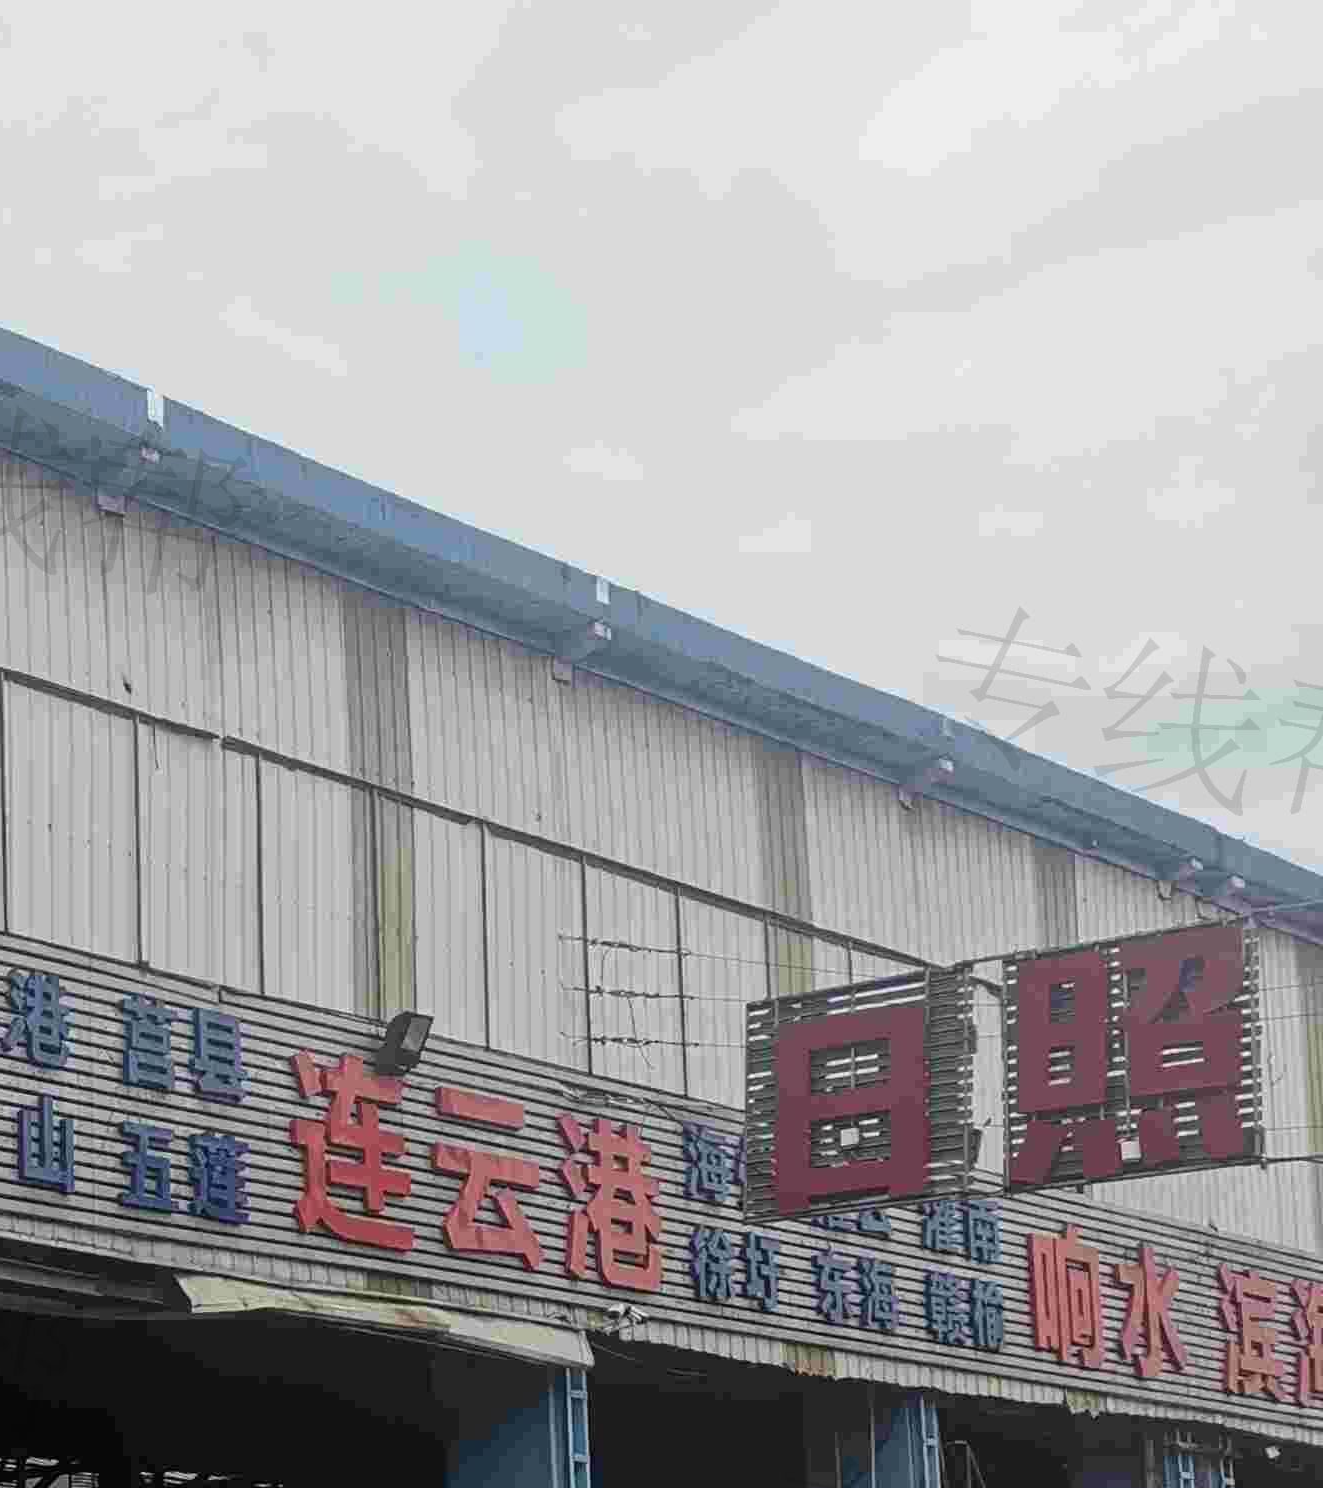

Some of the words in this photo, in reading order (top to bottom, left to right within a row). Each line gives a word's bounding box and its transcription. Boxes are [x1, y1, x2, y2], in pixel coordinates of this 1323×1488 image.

[118, 992, 252, 1103] 莒县
[771, 922, 1248, 1214] 日照
[117, 1120, 252, 1226] 五莲
[289, 1049, 665, 1295] 连云港
[682, 1120, 746, 1203] 海
[689, 1225, 780, 1313] 徐圩
[811, 1244, 902, 1332] 东海
[1025, 1224, 1191, 1377] 响水
